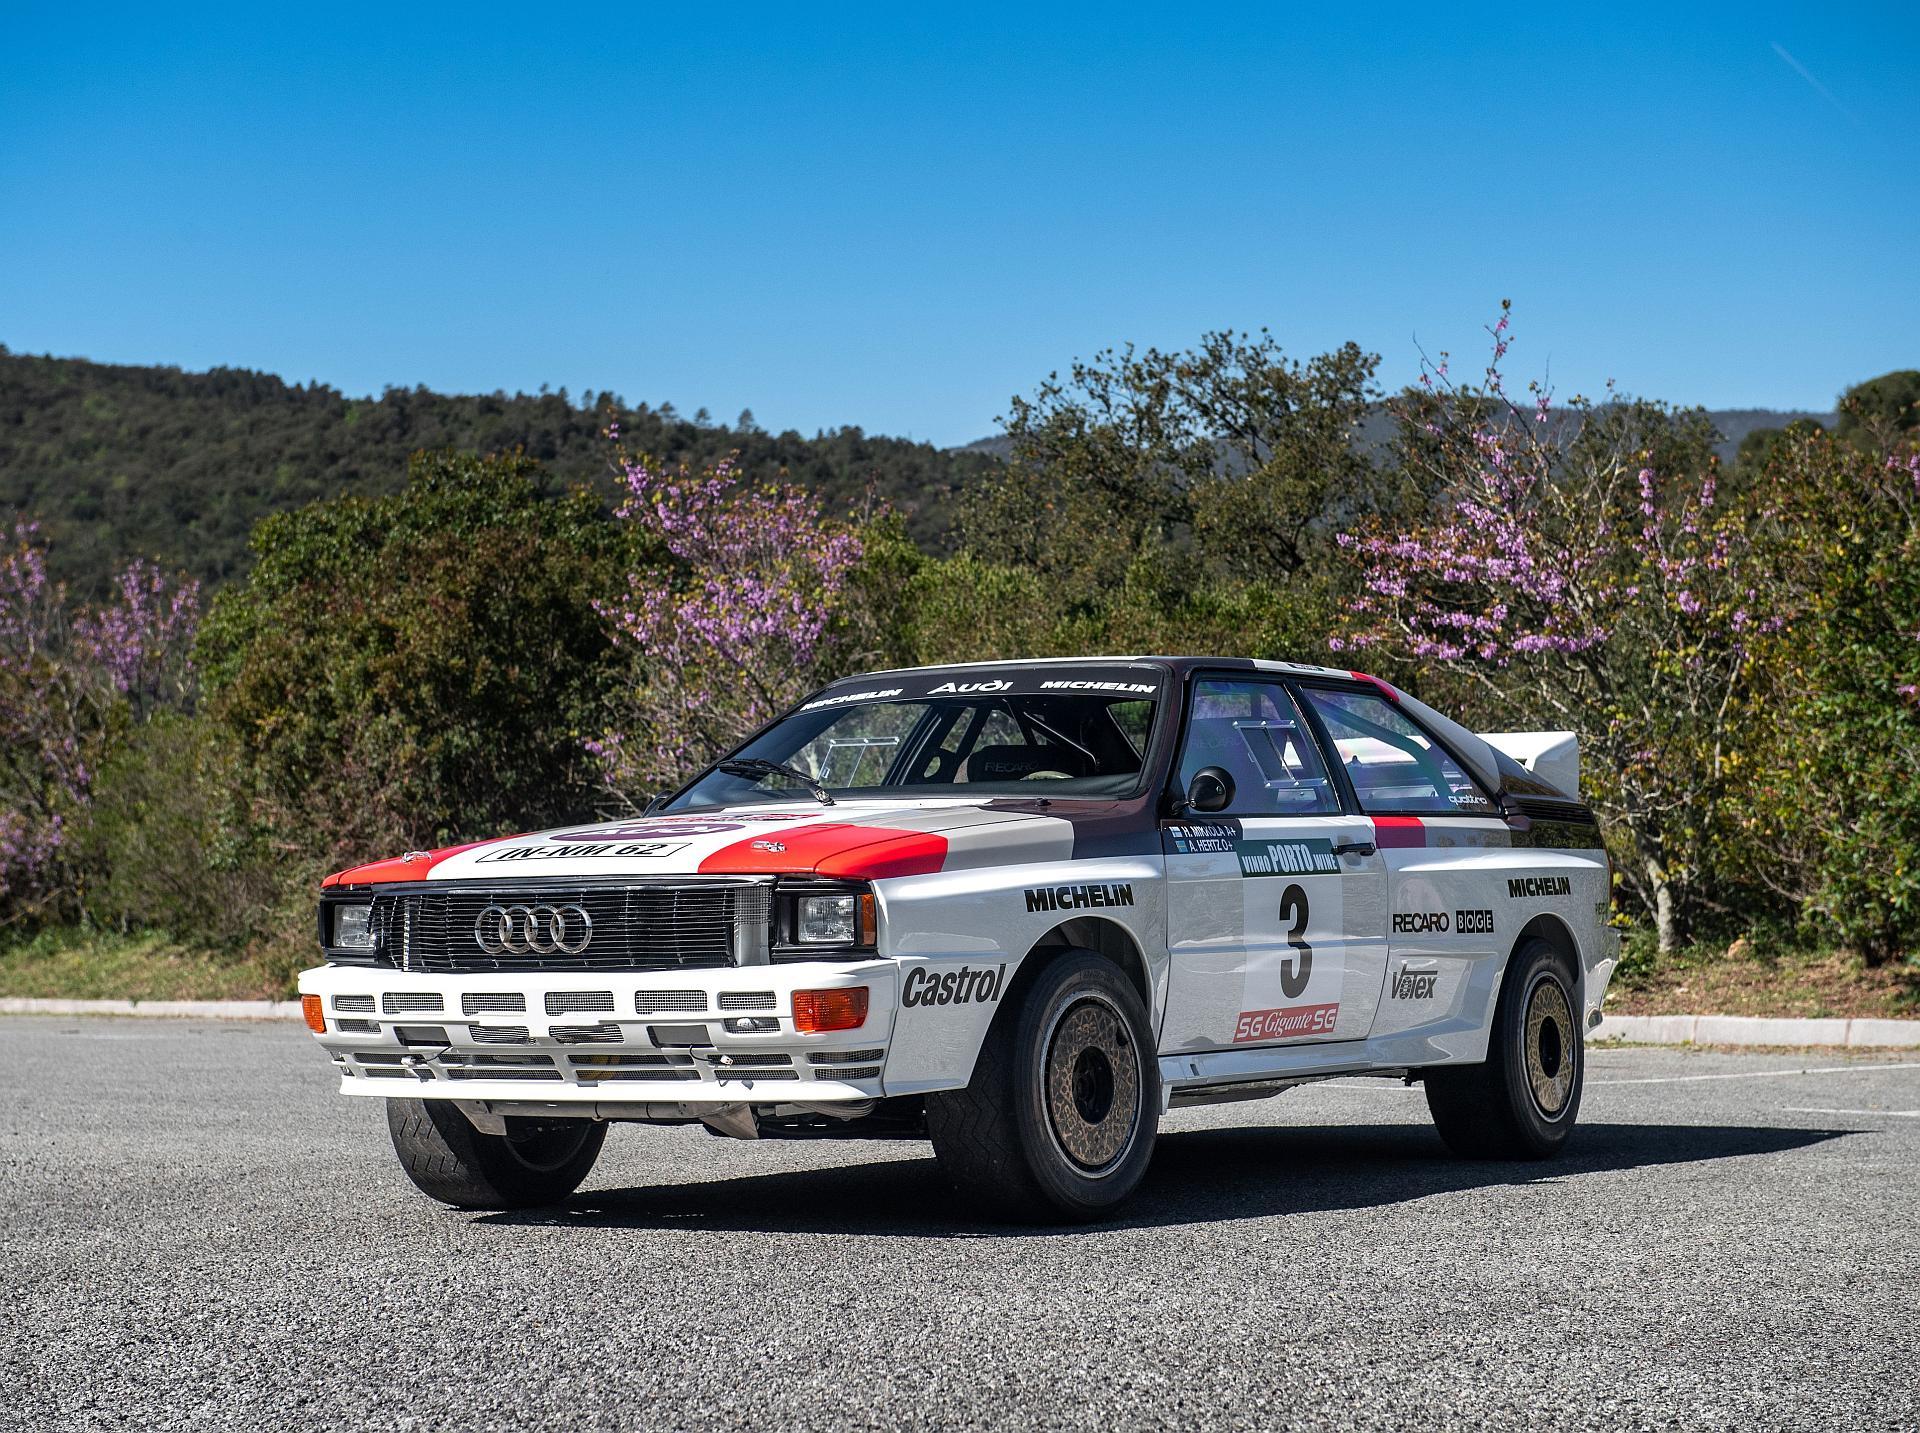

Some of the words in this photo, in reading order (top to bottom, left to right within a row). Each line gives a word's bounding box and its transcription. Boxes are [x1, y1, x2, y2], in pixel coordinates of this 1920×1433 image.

[926, 680, 1015, 695] Audi
[1039, 680, 1157, 694] MICHELIN
[799, 688, 904, 712] MICHELIN
[1447, 794, 1488, 806] quattro
[1181, 826, 1193, 838] H.
[496, 844, 616, 860] IN-NM
[614, 844, 669, 856] 62
[1189, 840, 1198, 852] A.
[1197, 839, 1223, 852] HERTZ
[1241, 855, 1272, 873] VINHO
[1267, 843, 1315, 873] PORTO
[1312, 853, 1338, 871] WINE
[1023, 884, 1135, 913] MICHELIN
[1507, 877, 1571, 898] MICHELIN
[1392, 912, 1450, 934] RECARO
[1456, 910, 1494, 934] BOGE
[1279, 883, 1313, 999] 3
[902, 963, 1007, 1009] Castrol
[1236, 1016, 1264, 1039] SG
[1264, 1011, 1313, 1037] Gigante
[1311, 1008, 1337, 1031] SG
